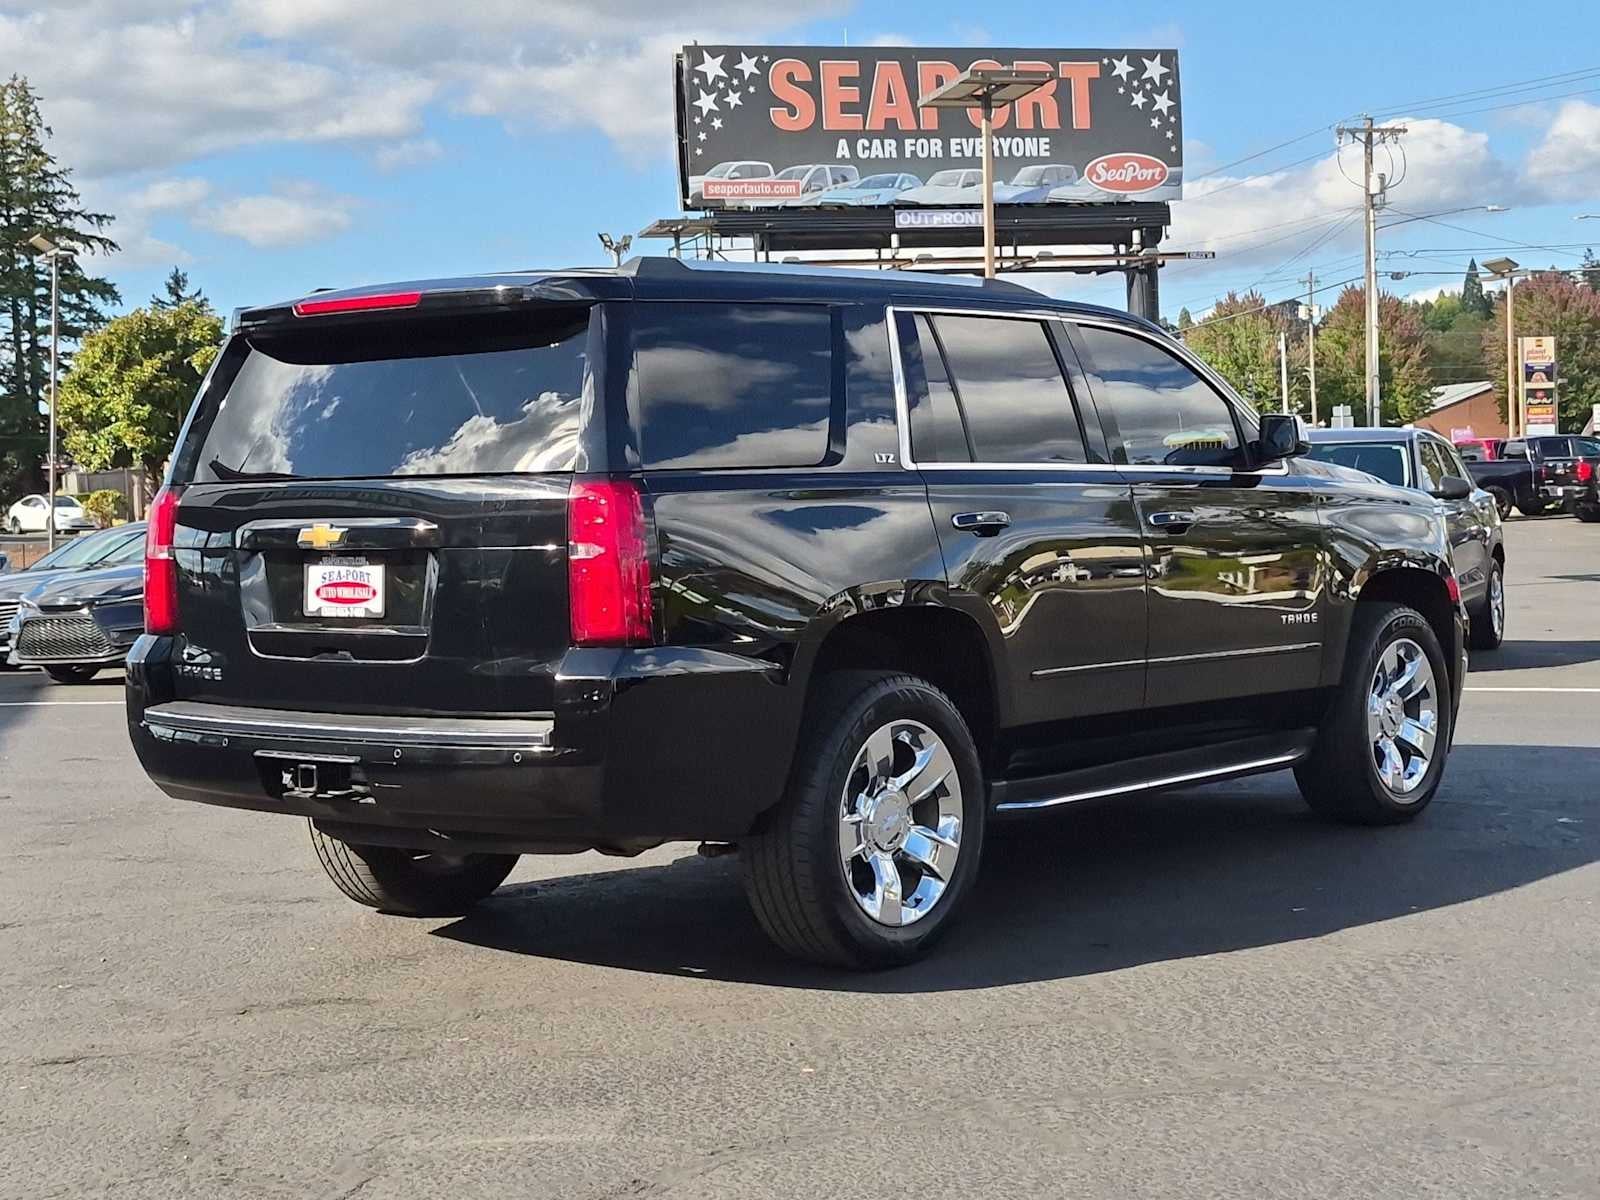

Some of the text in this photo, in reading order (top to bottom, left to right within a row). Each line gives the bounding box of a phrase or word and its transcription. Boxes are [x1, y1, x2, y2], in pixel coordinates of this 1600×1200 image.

[836, 139, 850, 158] A
[856, 139, 897, 158] CAR
[904, 138, 943, 158] FOR
[708, 183, 796, 196] seaportauto.com
[874, 452, 896, 463] LTZ
[1280, 612, 1318, 625] TAHOE
